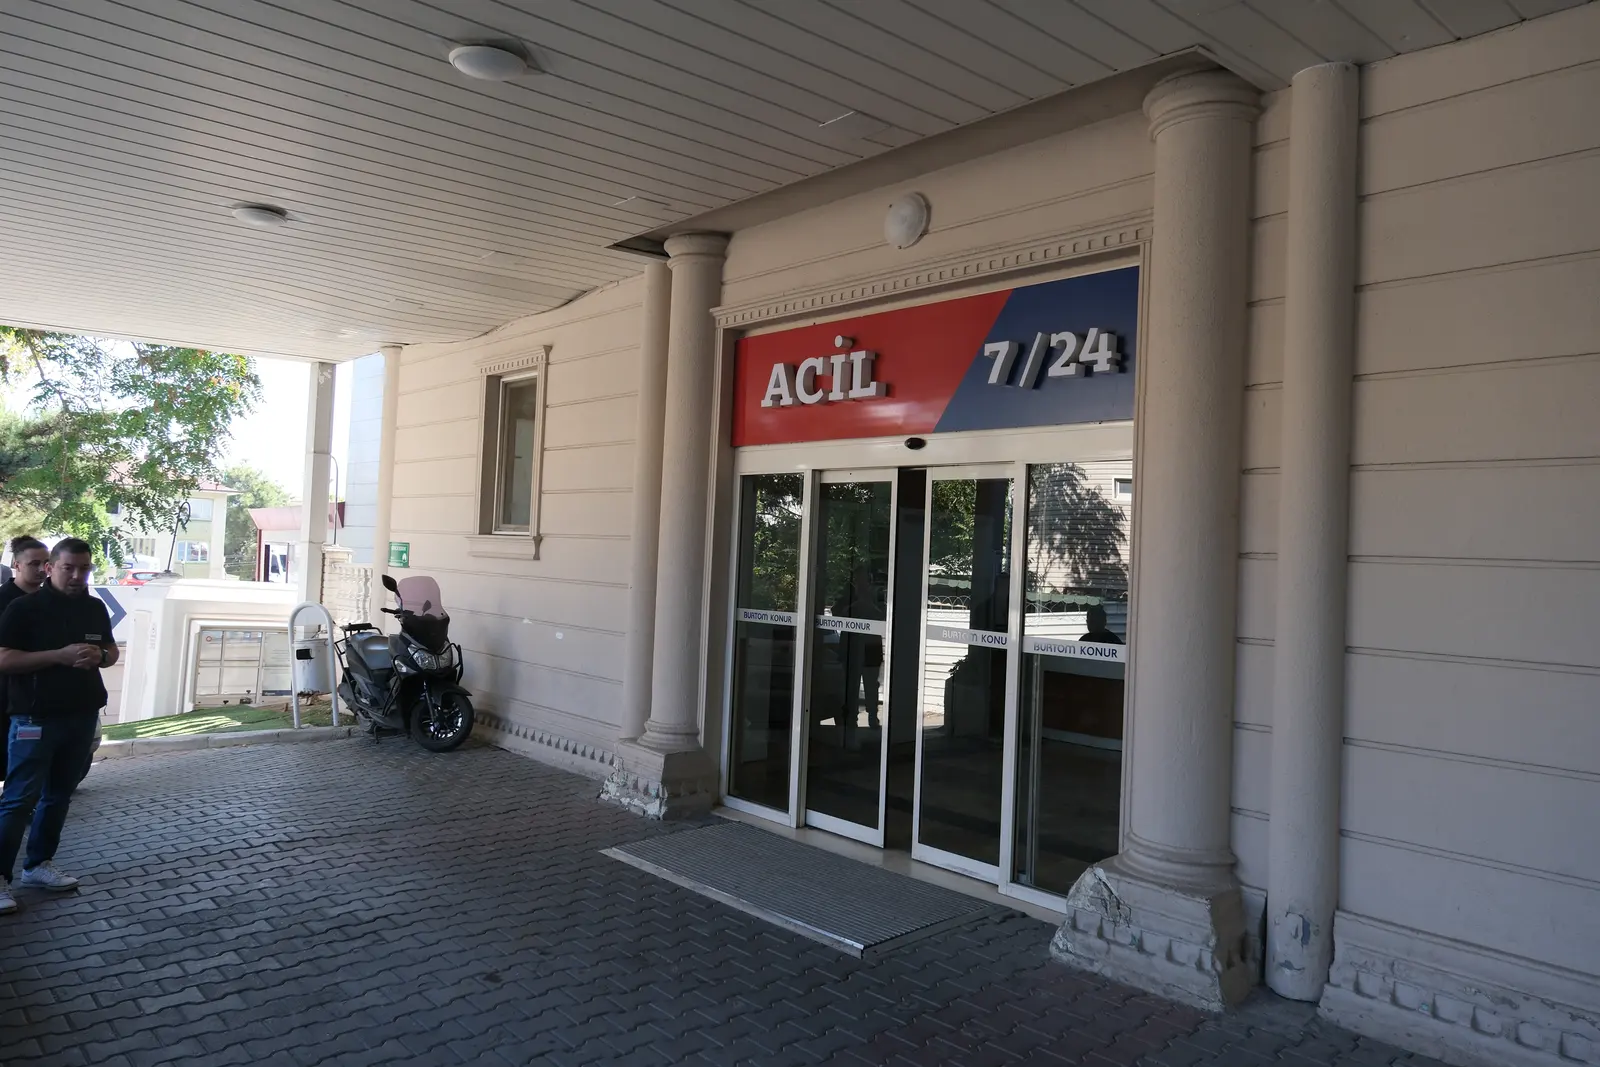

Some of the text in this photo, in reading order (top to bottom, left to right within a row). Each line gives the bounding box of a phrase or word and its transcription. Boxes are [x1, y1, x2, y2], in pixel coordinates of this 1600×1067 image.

[761, 327, 1123, 409] ACİL 7/24
[770, 614, 792, 623] KONUR
[845, 621, 871, 631] KONUR
[981, 633, 1008, 645] KONU
[1080, 646, 1118, 658] KONUR
